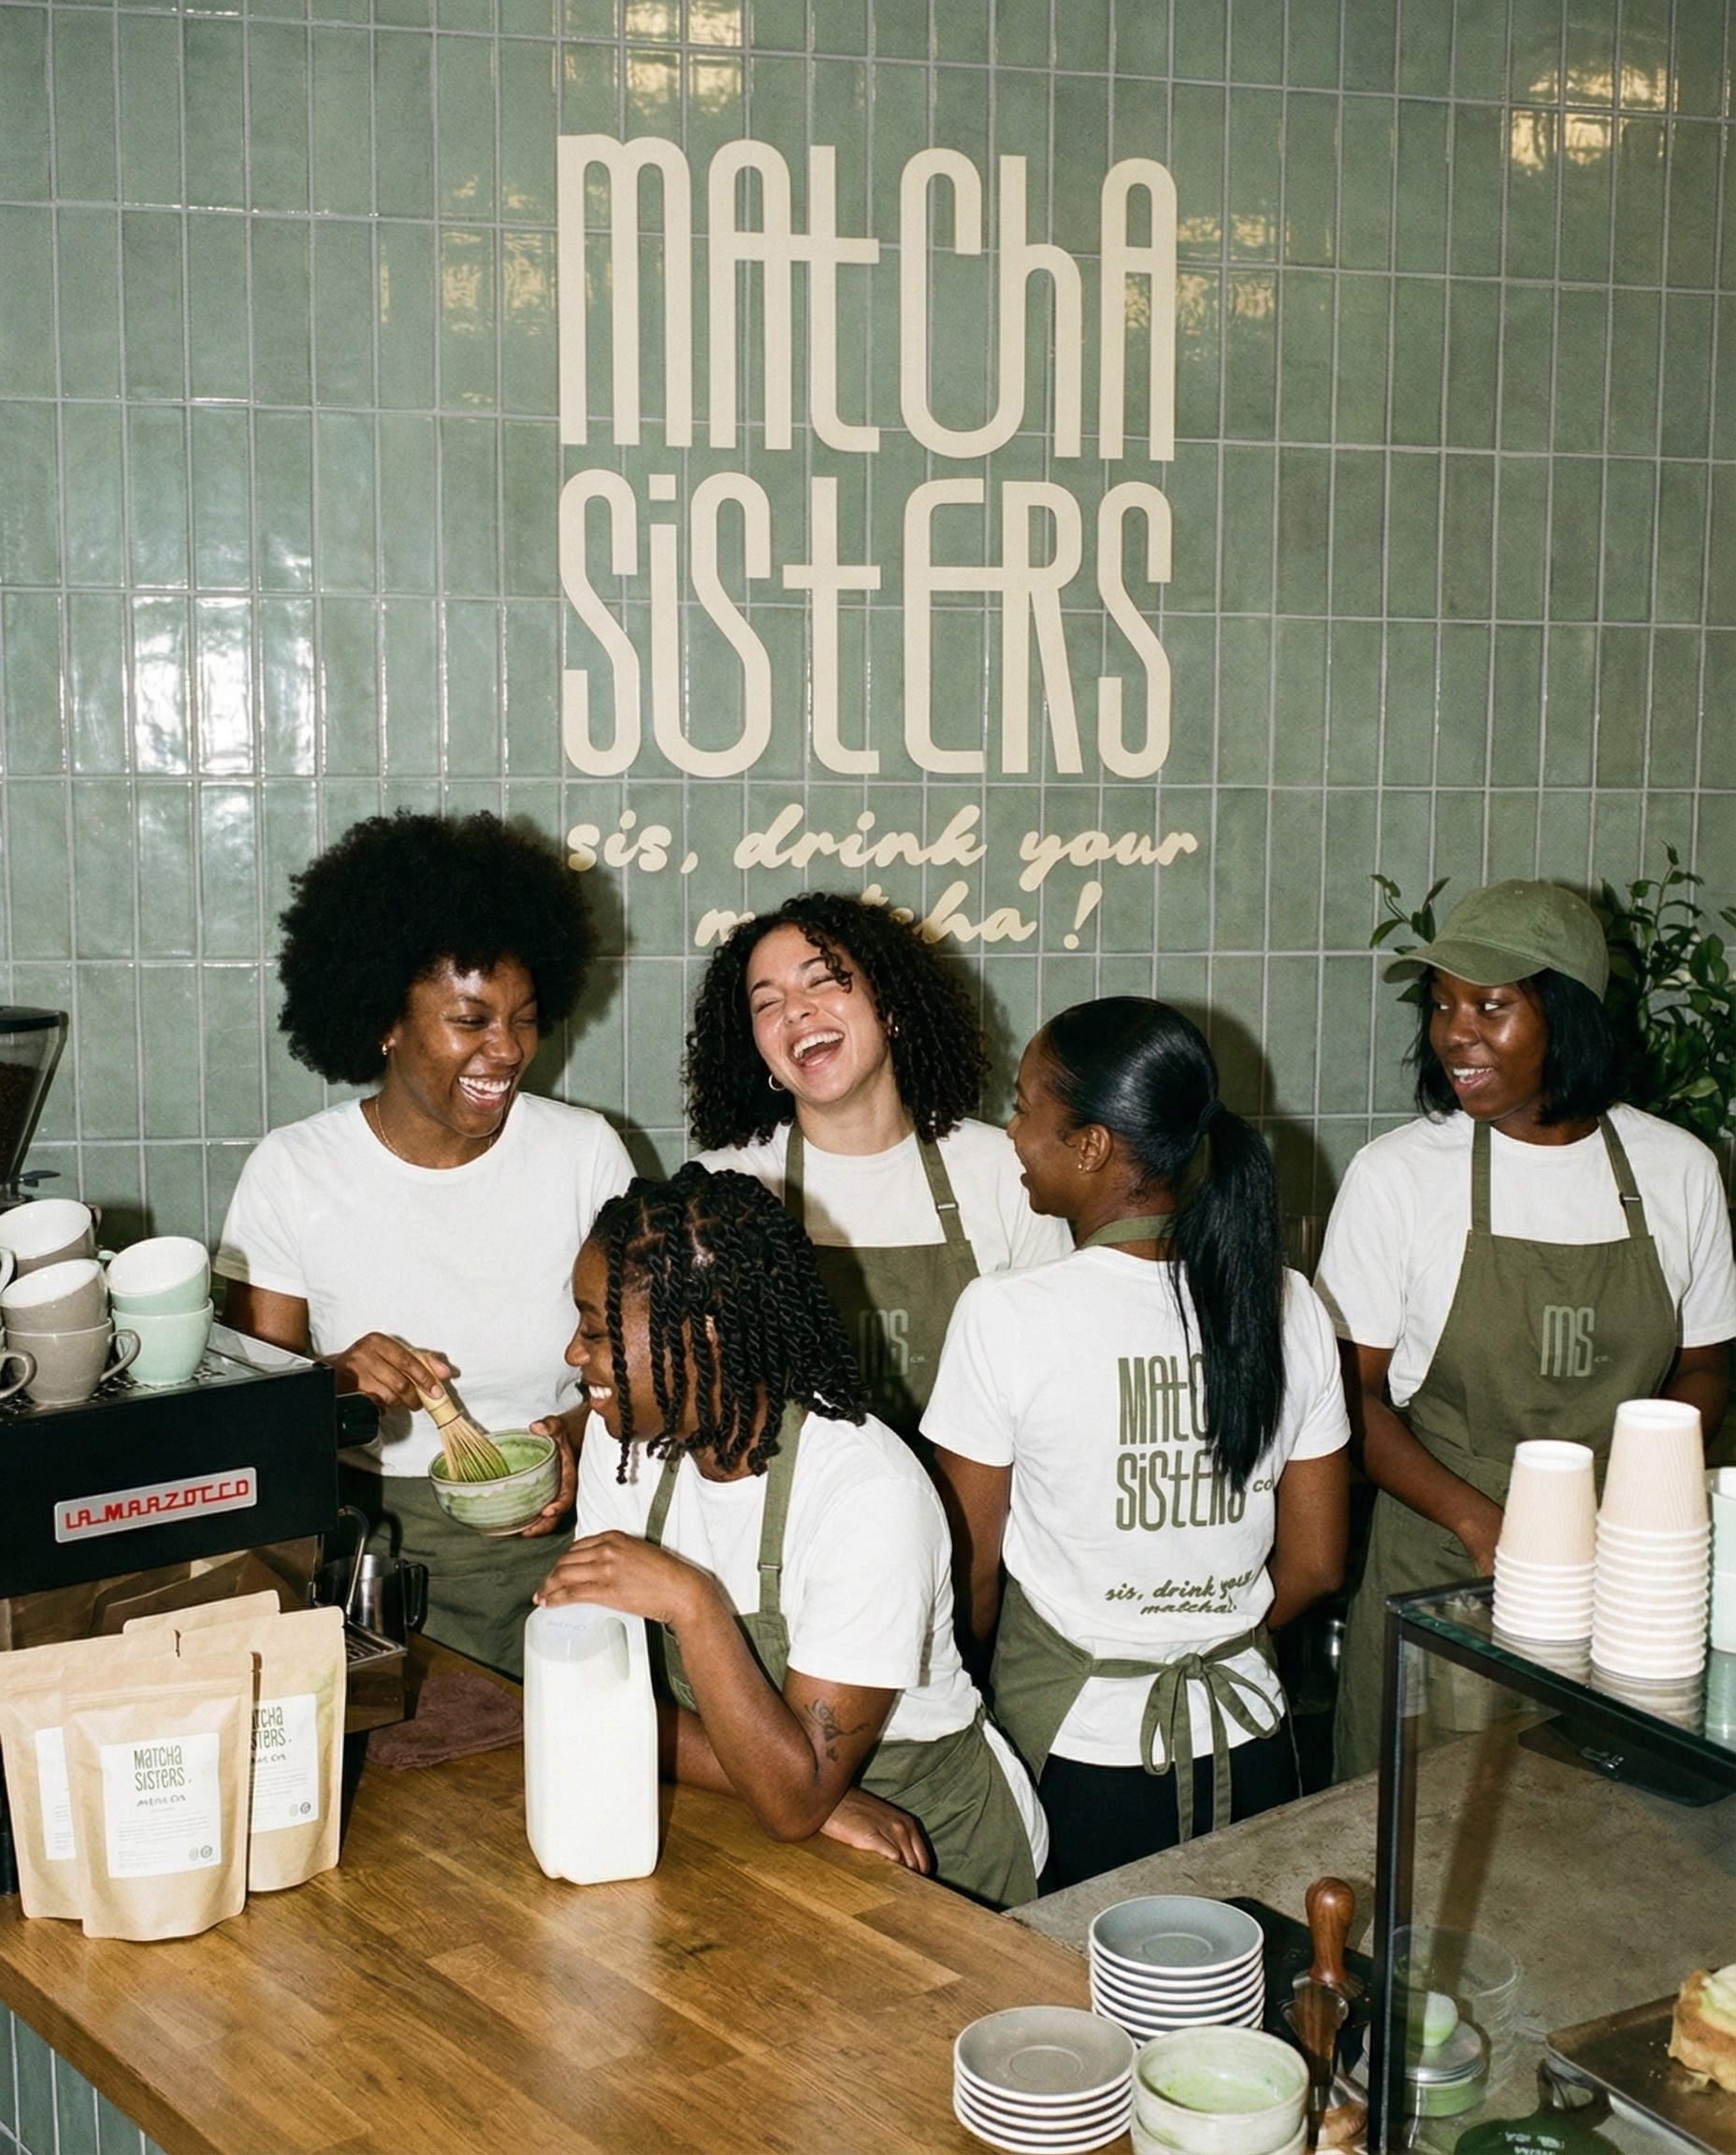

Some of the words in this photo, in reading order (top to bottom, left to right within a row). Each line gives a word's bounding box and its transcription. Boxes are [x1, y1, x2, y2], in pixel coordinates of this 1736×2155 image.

[566, 810, 698, 874] sis,
[733, 803, 988, 870] drink
[1019, 829, 1198, 891] your
[695, 881, 1037, 947] mha
[1152, 1575, 1216, 1598] drink
